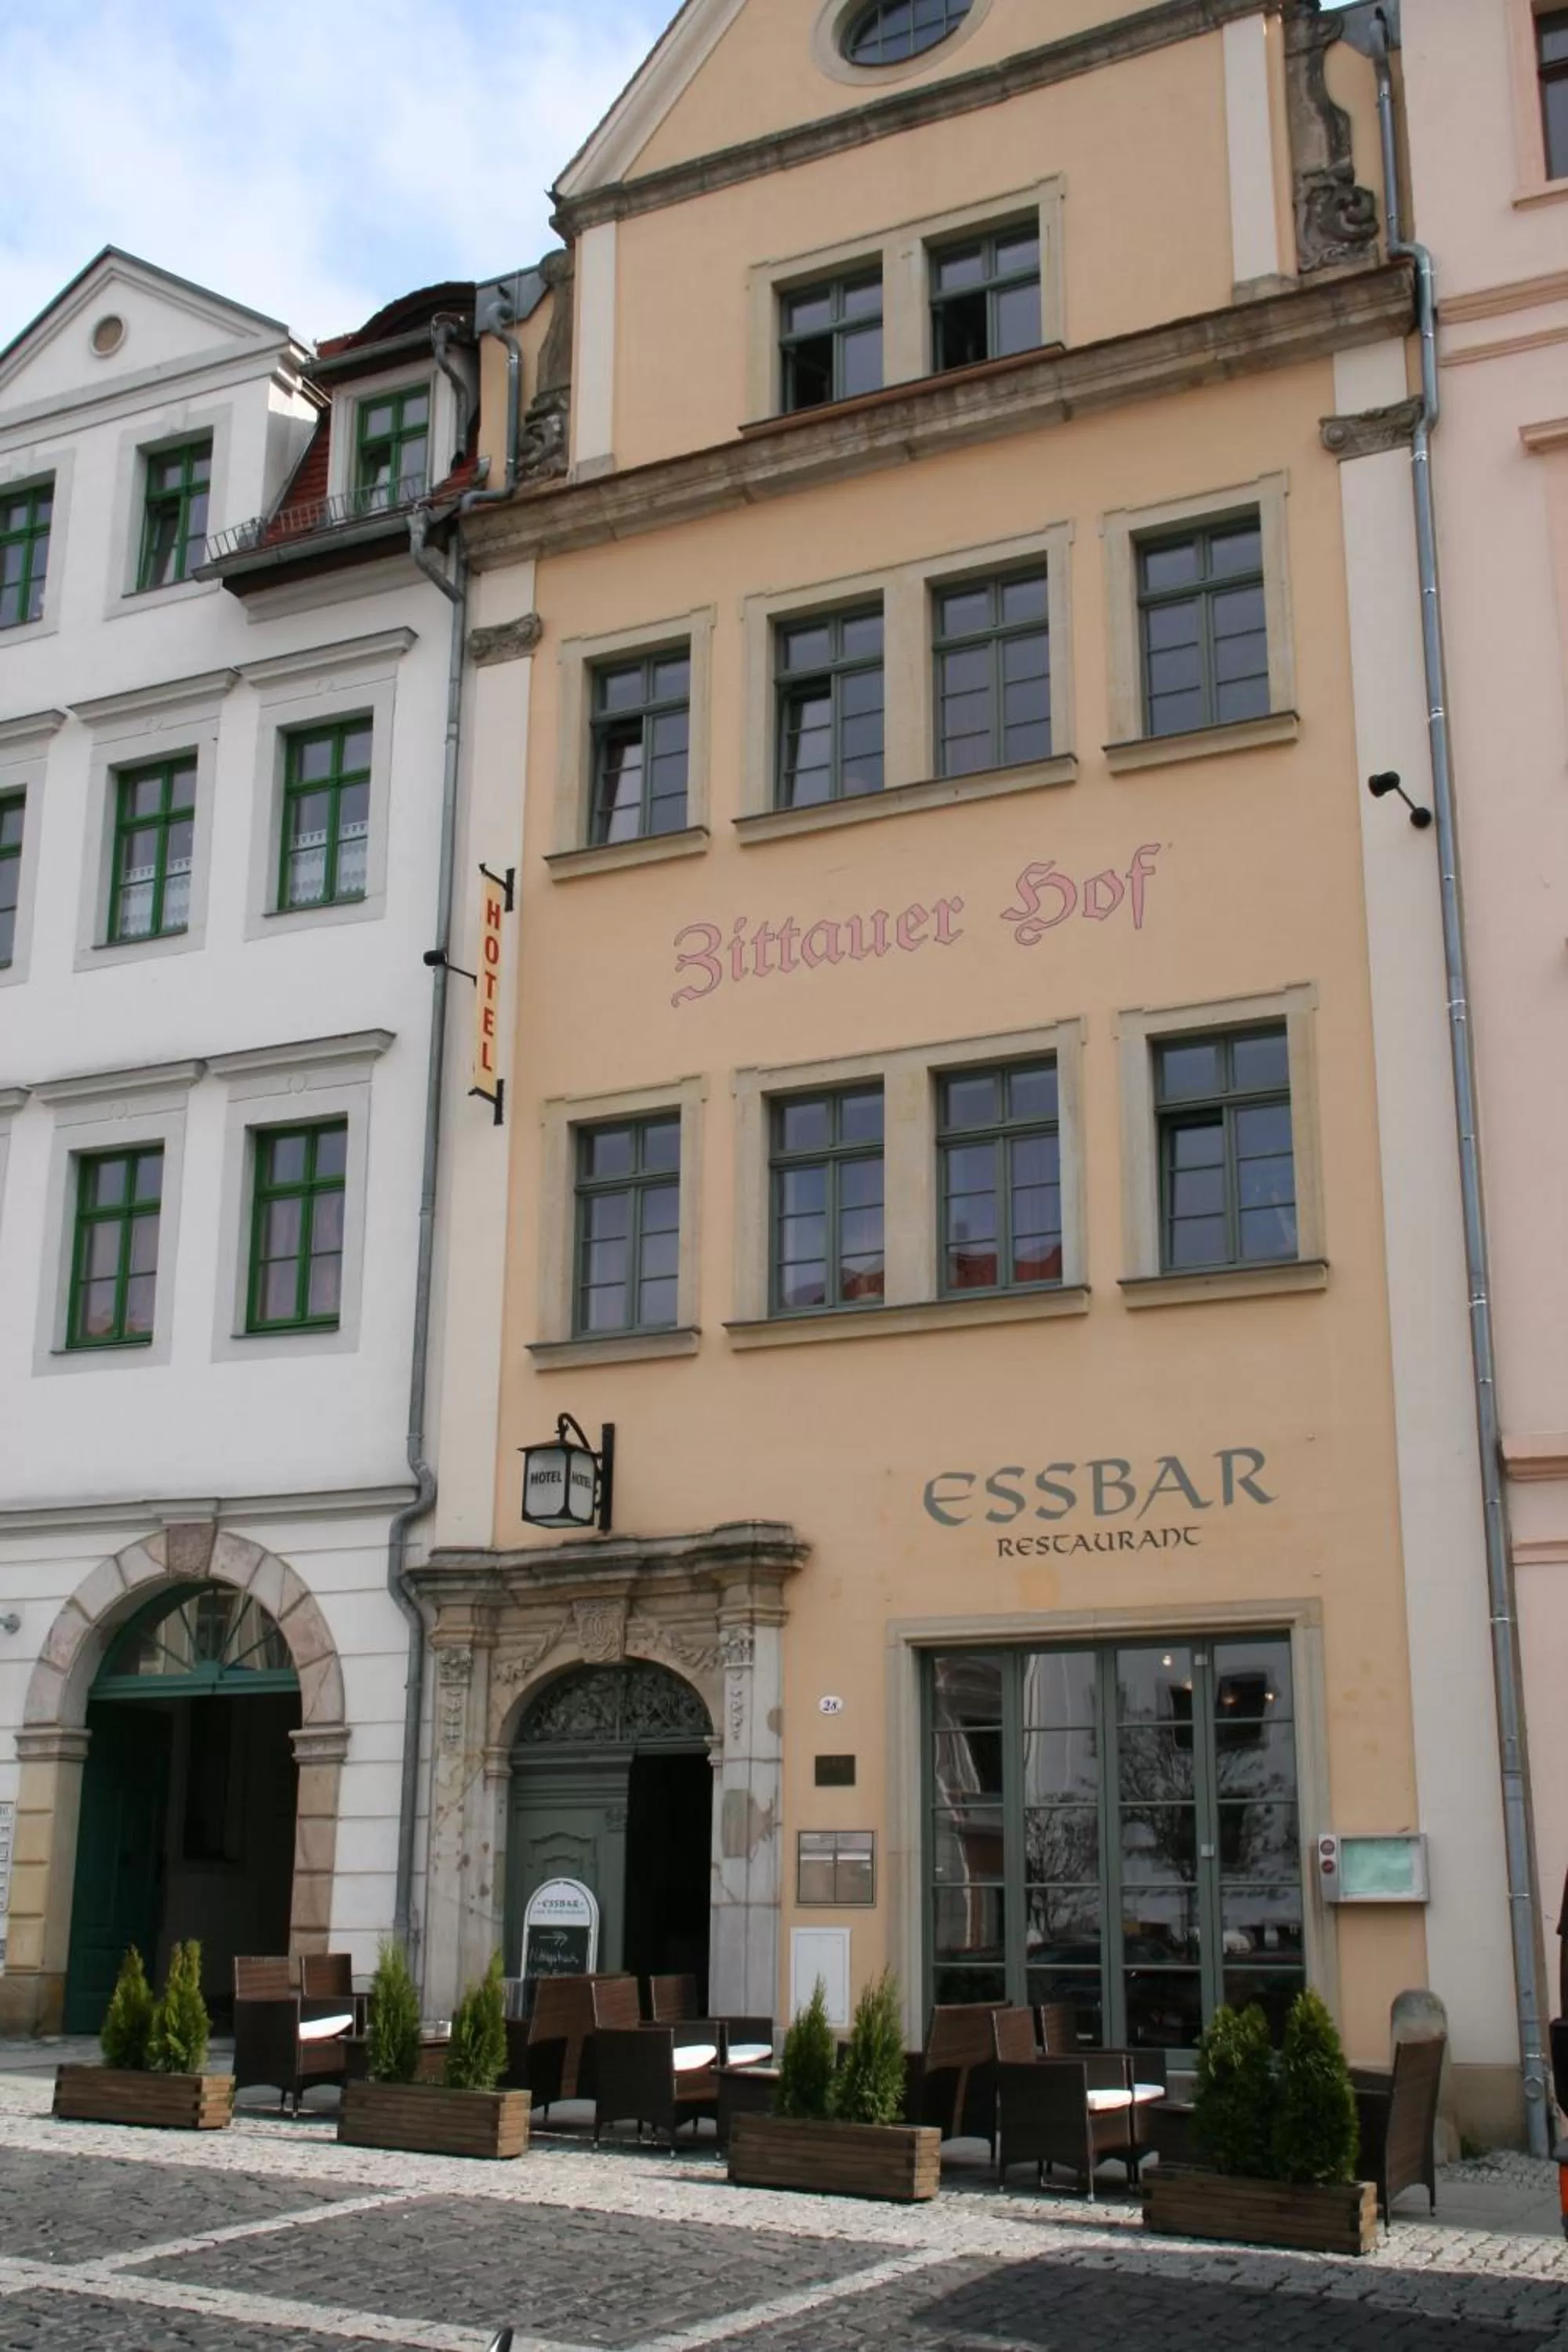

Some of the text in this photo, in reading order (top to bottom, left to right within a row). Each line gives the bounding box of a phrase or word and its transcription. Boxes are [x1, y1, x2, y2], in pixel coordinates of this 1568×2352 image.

[671, 844, 1161, 1007] Zittauer Hof
[481, 899, 501, 1073] HOTEL
[531, 1470, 562, 1485] HOTEL
[571, 1471, 592, 1489] HOTEL
[923, 1446, 1279, 1526] ESSBAR
[996, 1526, 1202, 1557] RESTAURANT
